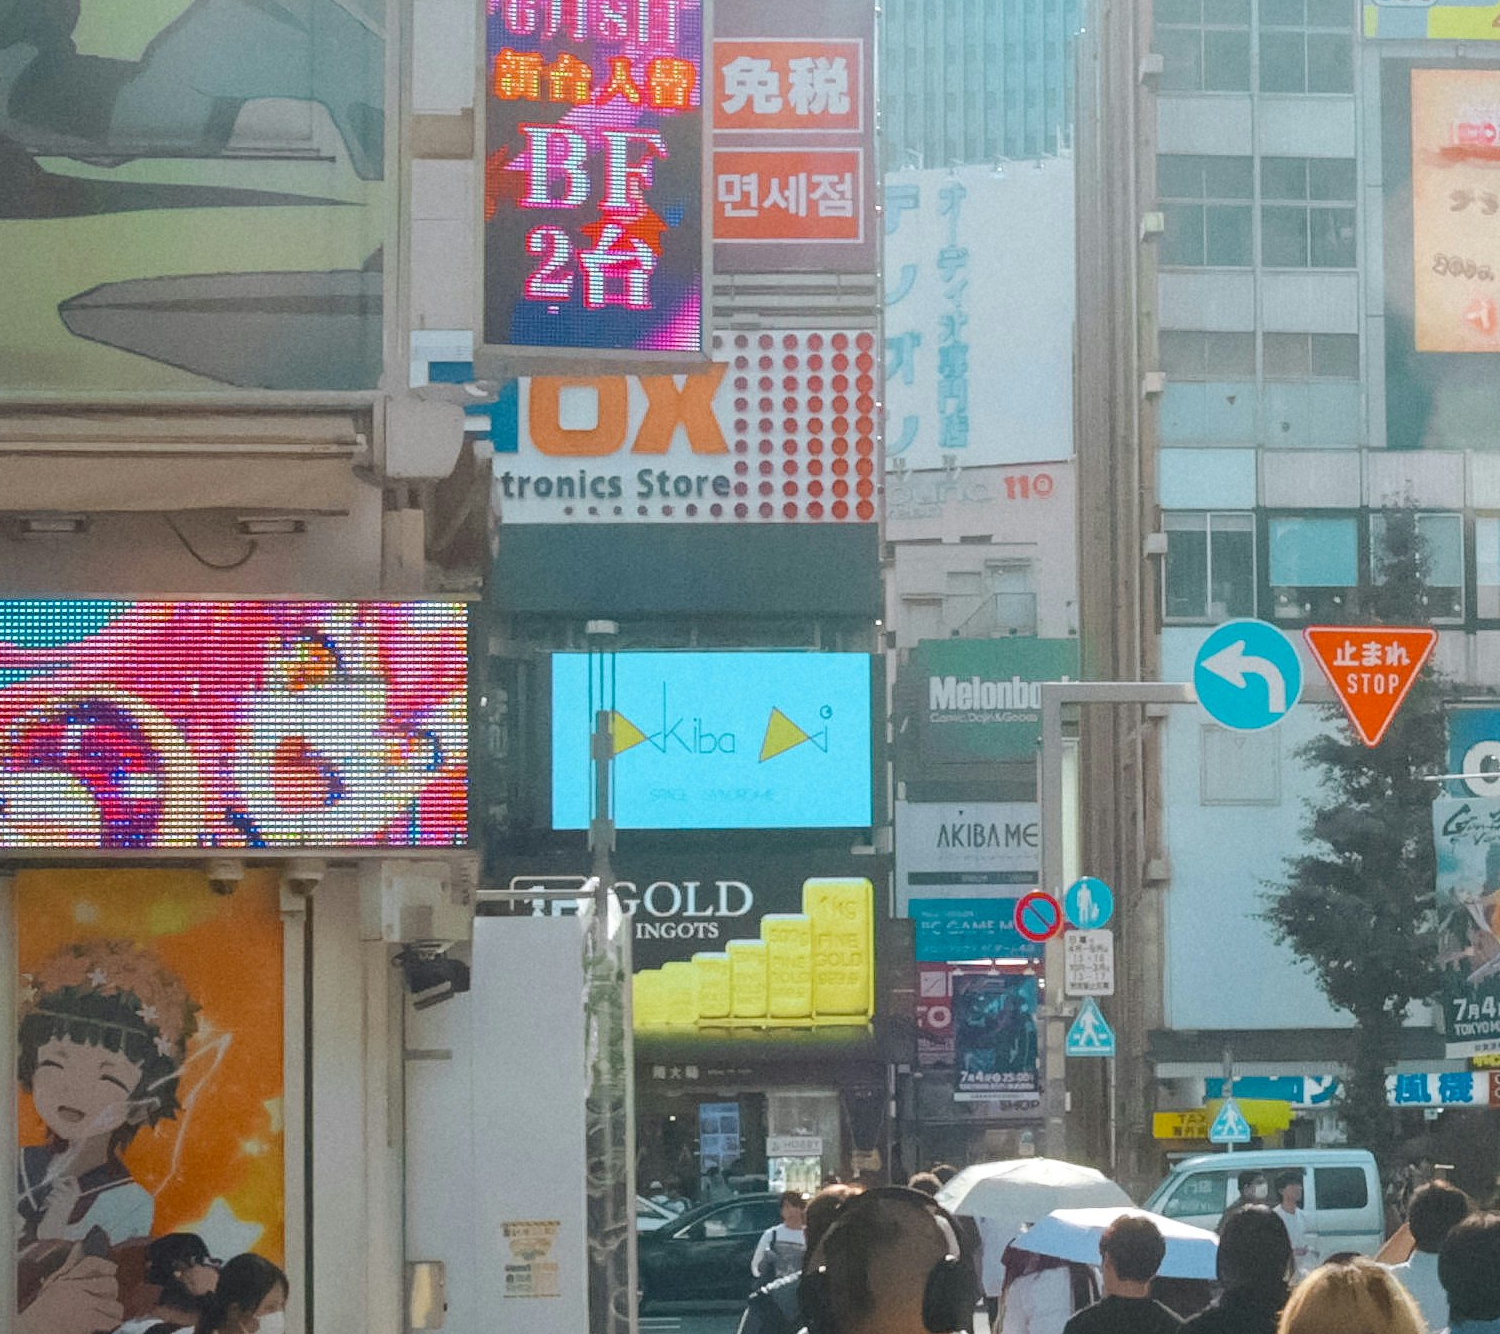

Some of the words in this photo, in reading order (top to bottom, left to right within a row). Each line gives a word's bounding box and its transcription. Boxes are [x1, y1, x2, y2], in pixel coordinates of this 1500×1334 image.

[494, 50, 697, 109] 新台入替
[721, 56, 850, 116] 免税
[518, 122, 669, 210] BF
[717, 172, 853, 218] 면세점
[525, 224, 659, 311] 2台
[529, 361, 730, 456] OX
[502, 470, 622, 500] tronics
[638, 468, 731, 499] Store
[1003, 474, 1053, 499] 110
[1332, 640, 1410, 667] 止まれ
[929, 676, 1041, 710] Melonbo
[1347, 673, 1400, 695] STOP
[614, 881, 754, 917] GOLD
[636, 922, 719, 939] INGOTS
[1393, 1071, 1472, 1104] 風機
